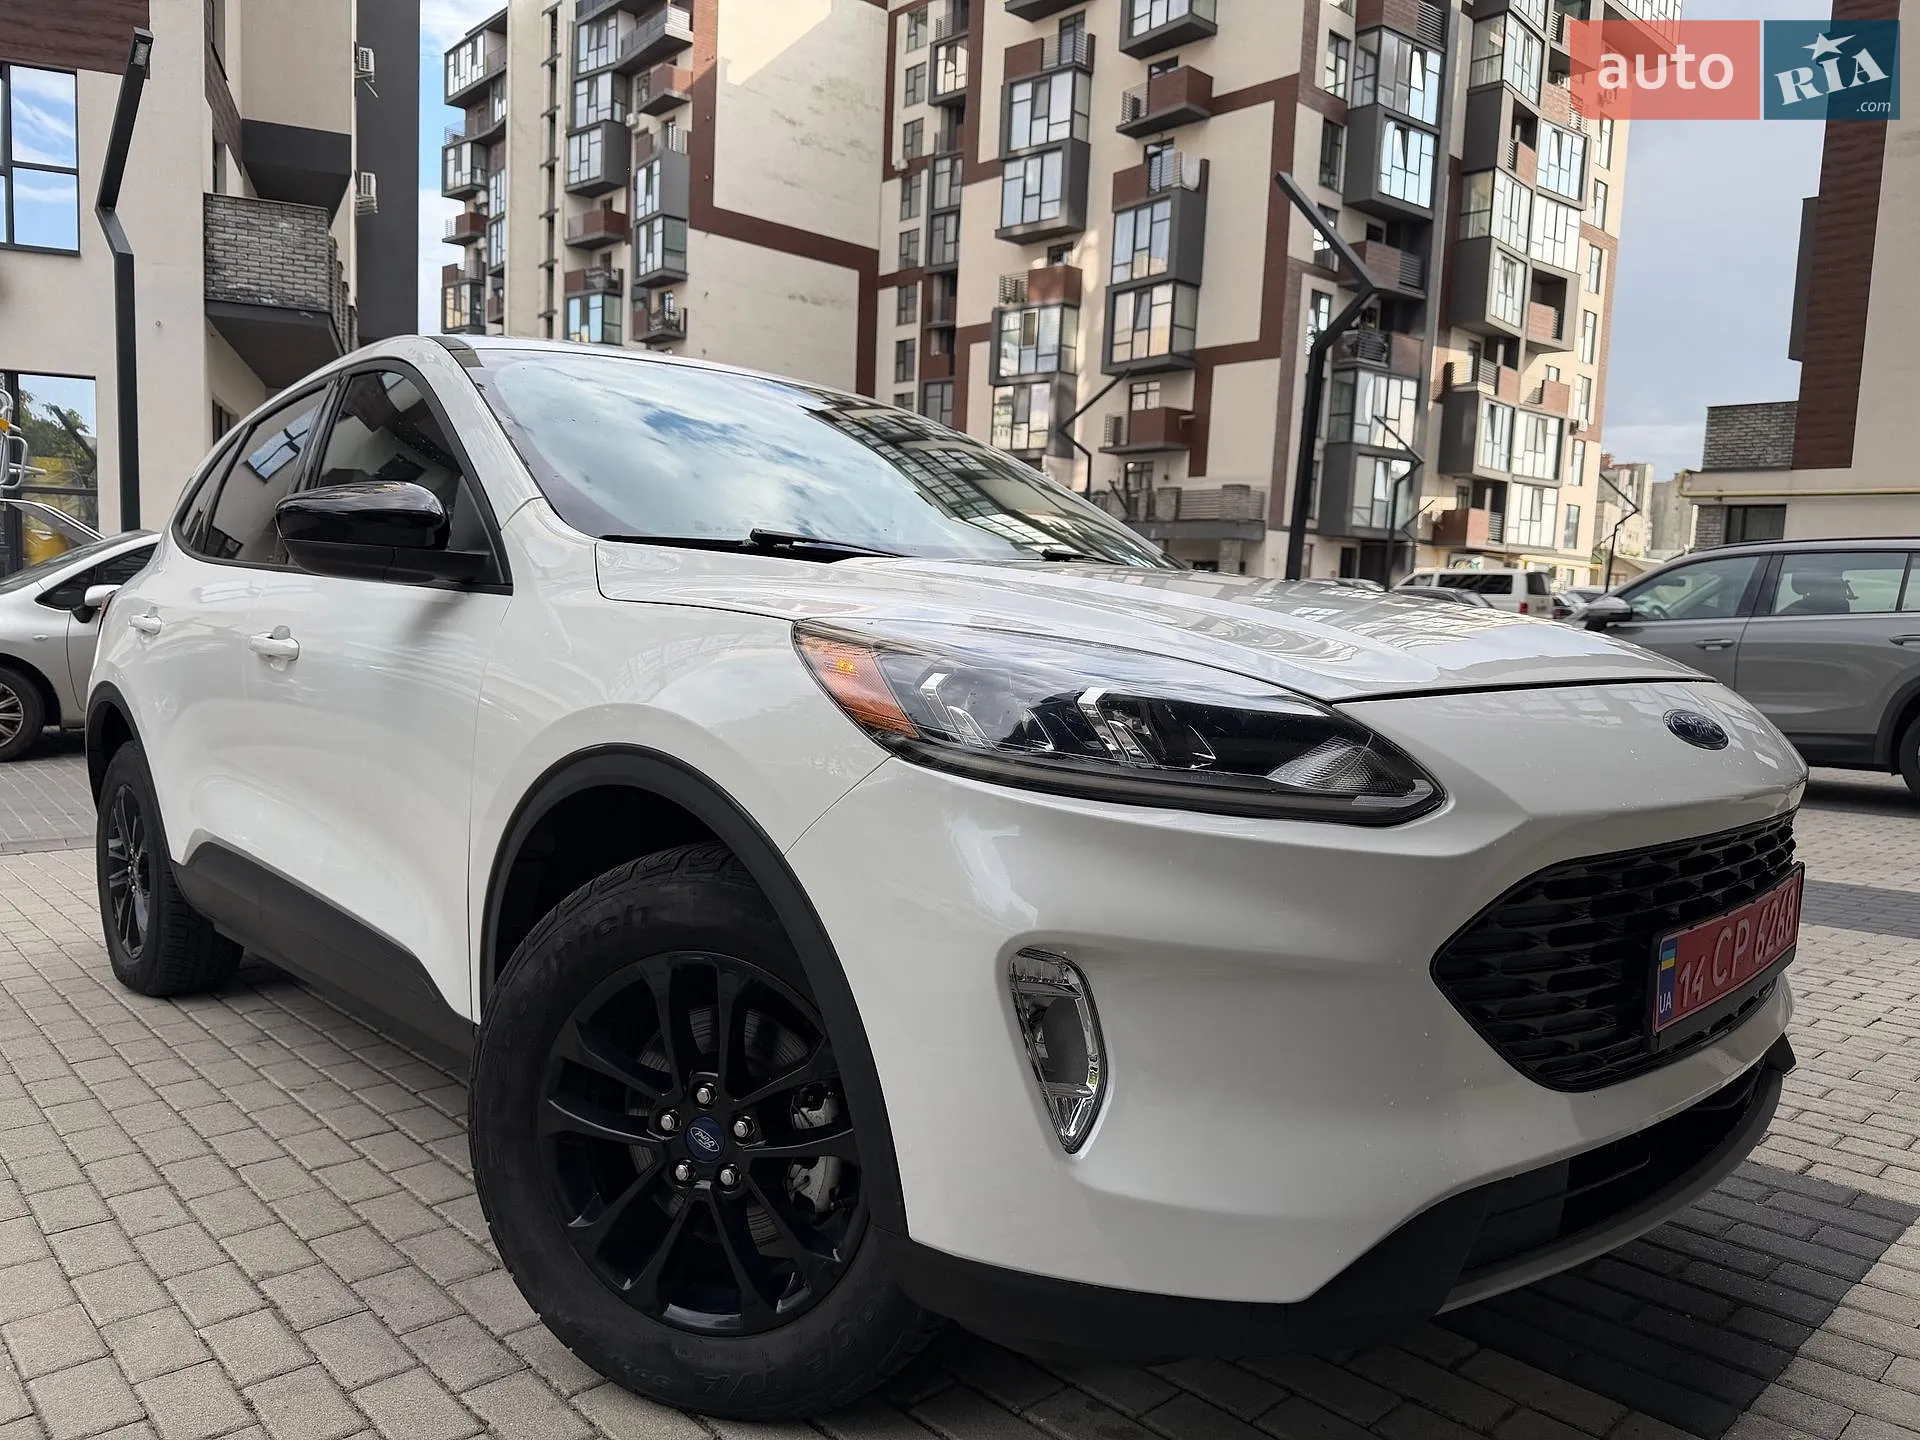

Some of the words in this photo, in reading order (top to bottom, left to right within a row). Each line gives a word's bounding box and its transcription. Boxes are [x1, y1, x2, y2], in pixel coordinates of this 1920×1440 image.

[1680, 957, 1706, 1008] 14
[1712, 918, 1750, 989] CP
[1659, 991, 1672, 1013] UA
